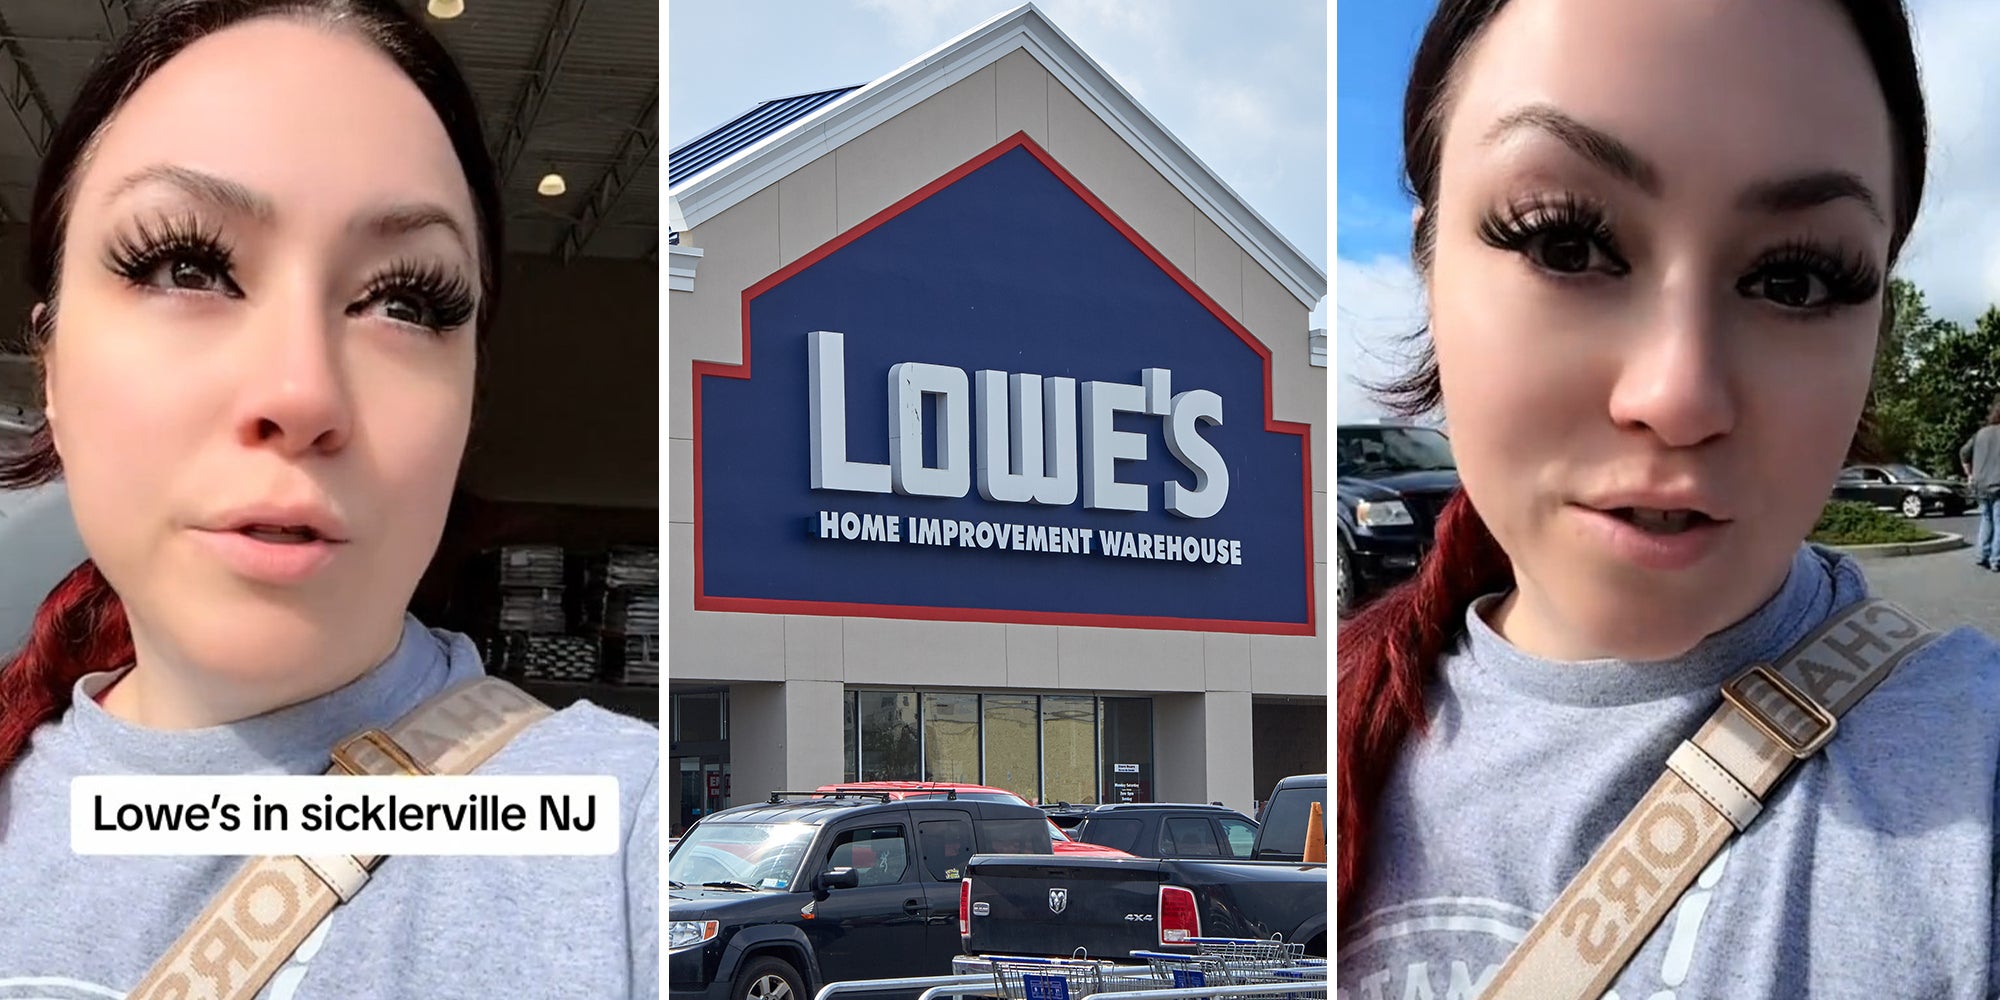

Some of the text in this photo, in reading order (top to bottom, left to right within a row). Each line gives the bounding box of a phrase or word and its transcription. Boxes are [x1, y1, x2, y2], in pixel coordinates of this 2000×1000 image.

[808, 331, 1229, 518] LOWE'S
[820, 511, 1242, 565] HOME IMPROVEMENT WAREHOUSE
